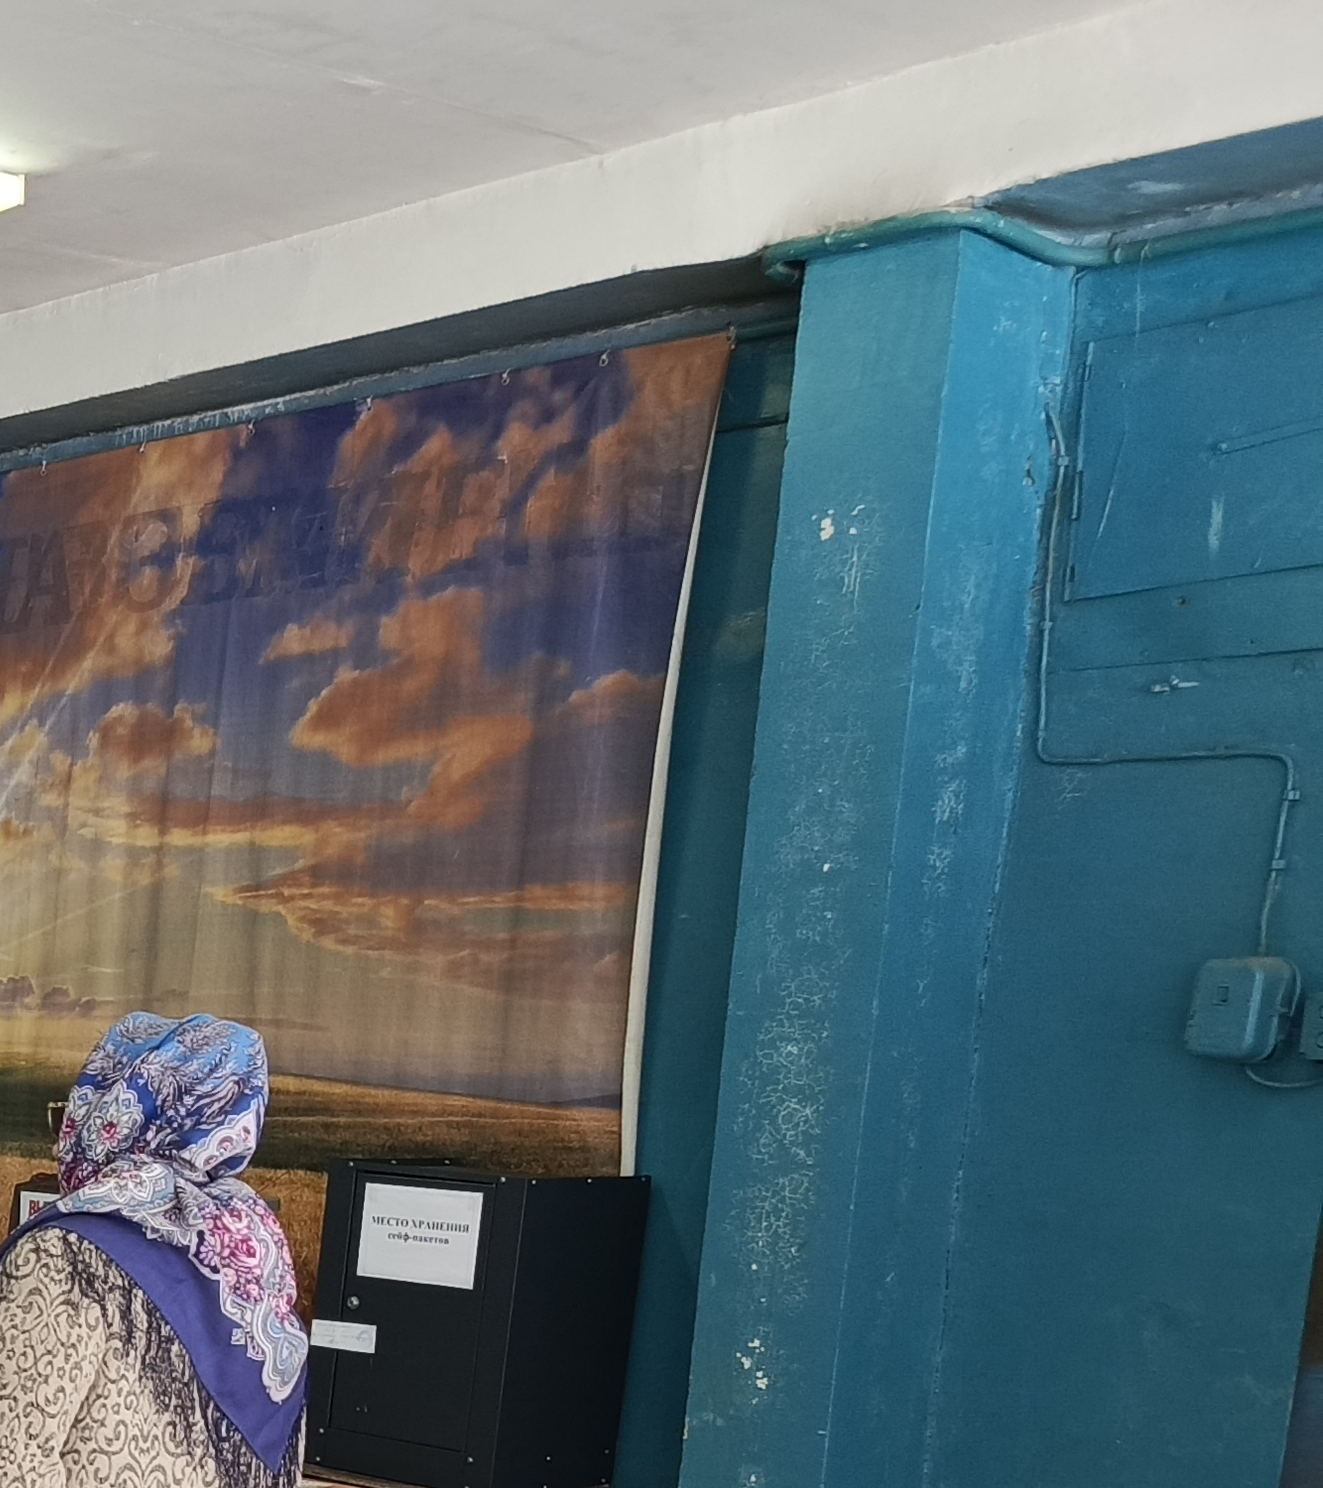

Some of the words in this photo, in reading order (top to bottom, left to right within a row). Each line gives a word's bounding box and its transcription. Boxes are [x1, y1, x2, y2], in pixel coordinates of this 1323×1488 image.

[371, 1215, 409, 1228] МЕСТО
[411, 1219, 470, 1234] ХРАНЕНИЯ
[387, 1231, 450, 1245] сейф-пакетов
